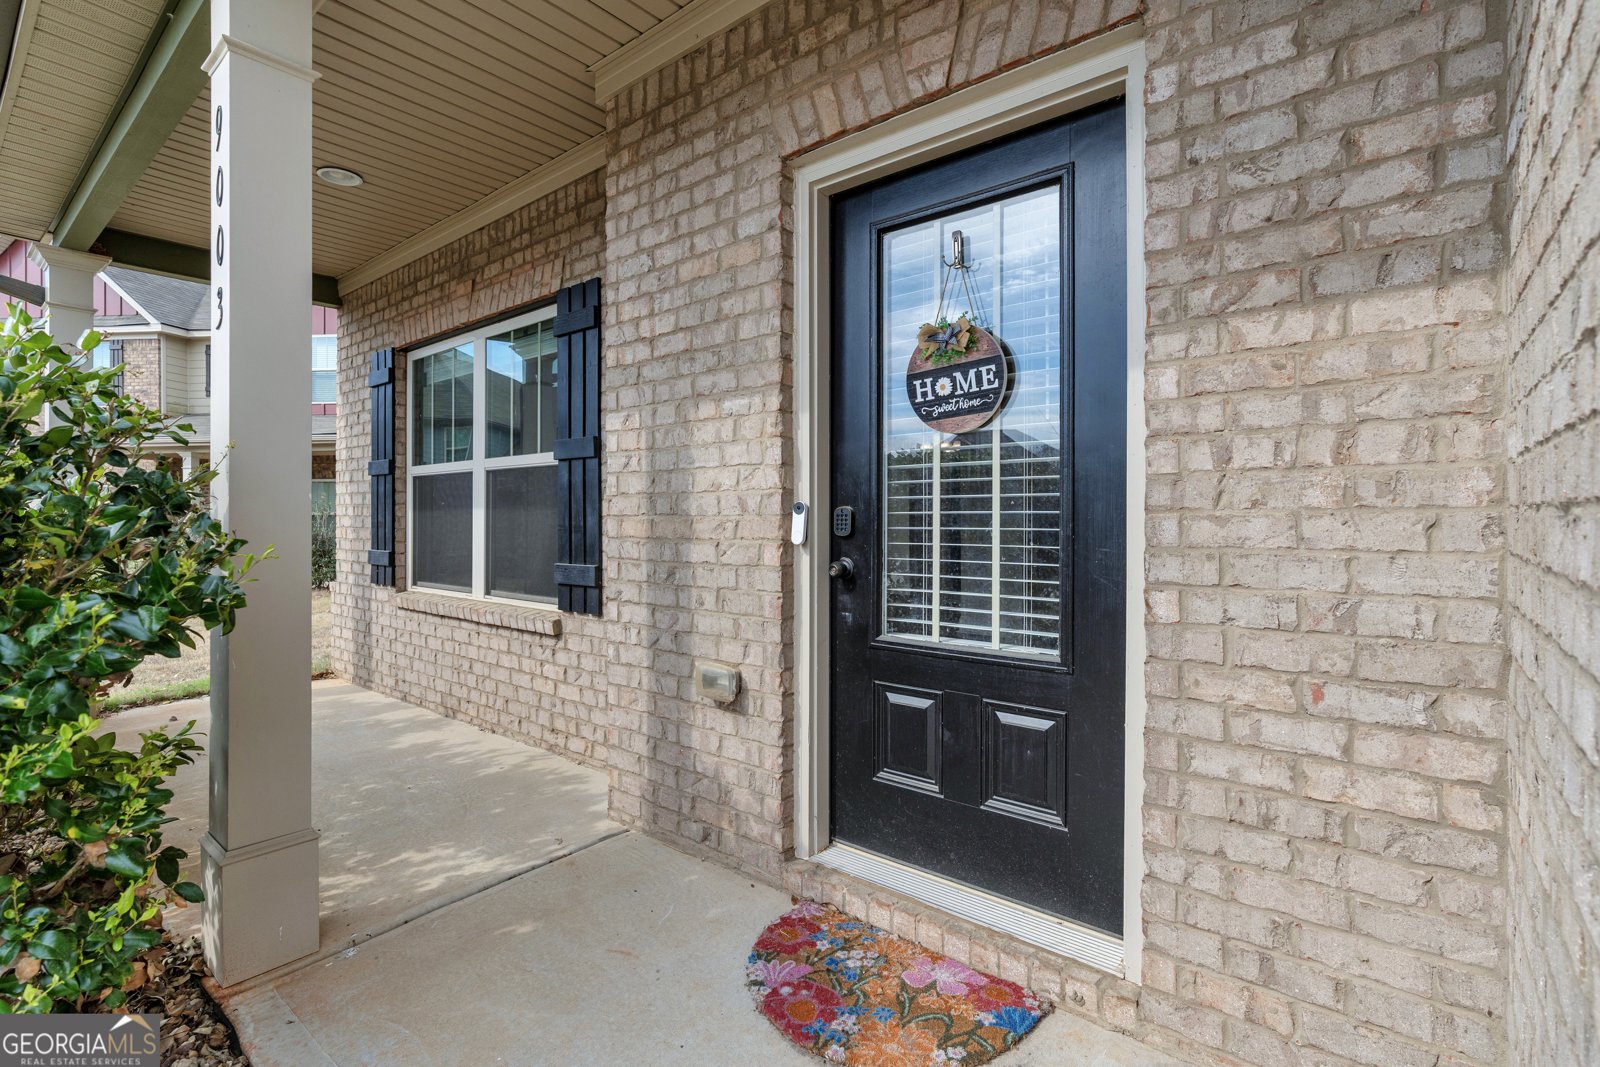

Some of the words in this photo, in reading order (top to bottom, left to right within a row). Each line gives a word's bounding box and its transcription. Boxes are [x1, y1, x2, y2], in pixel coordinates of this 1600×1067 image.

[215, 105, 225, 330] 9003
[913, 364, 999, 402] HOME
[921, 398, 960, 416] sweet
[959, 394, 994, 409] home
